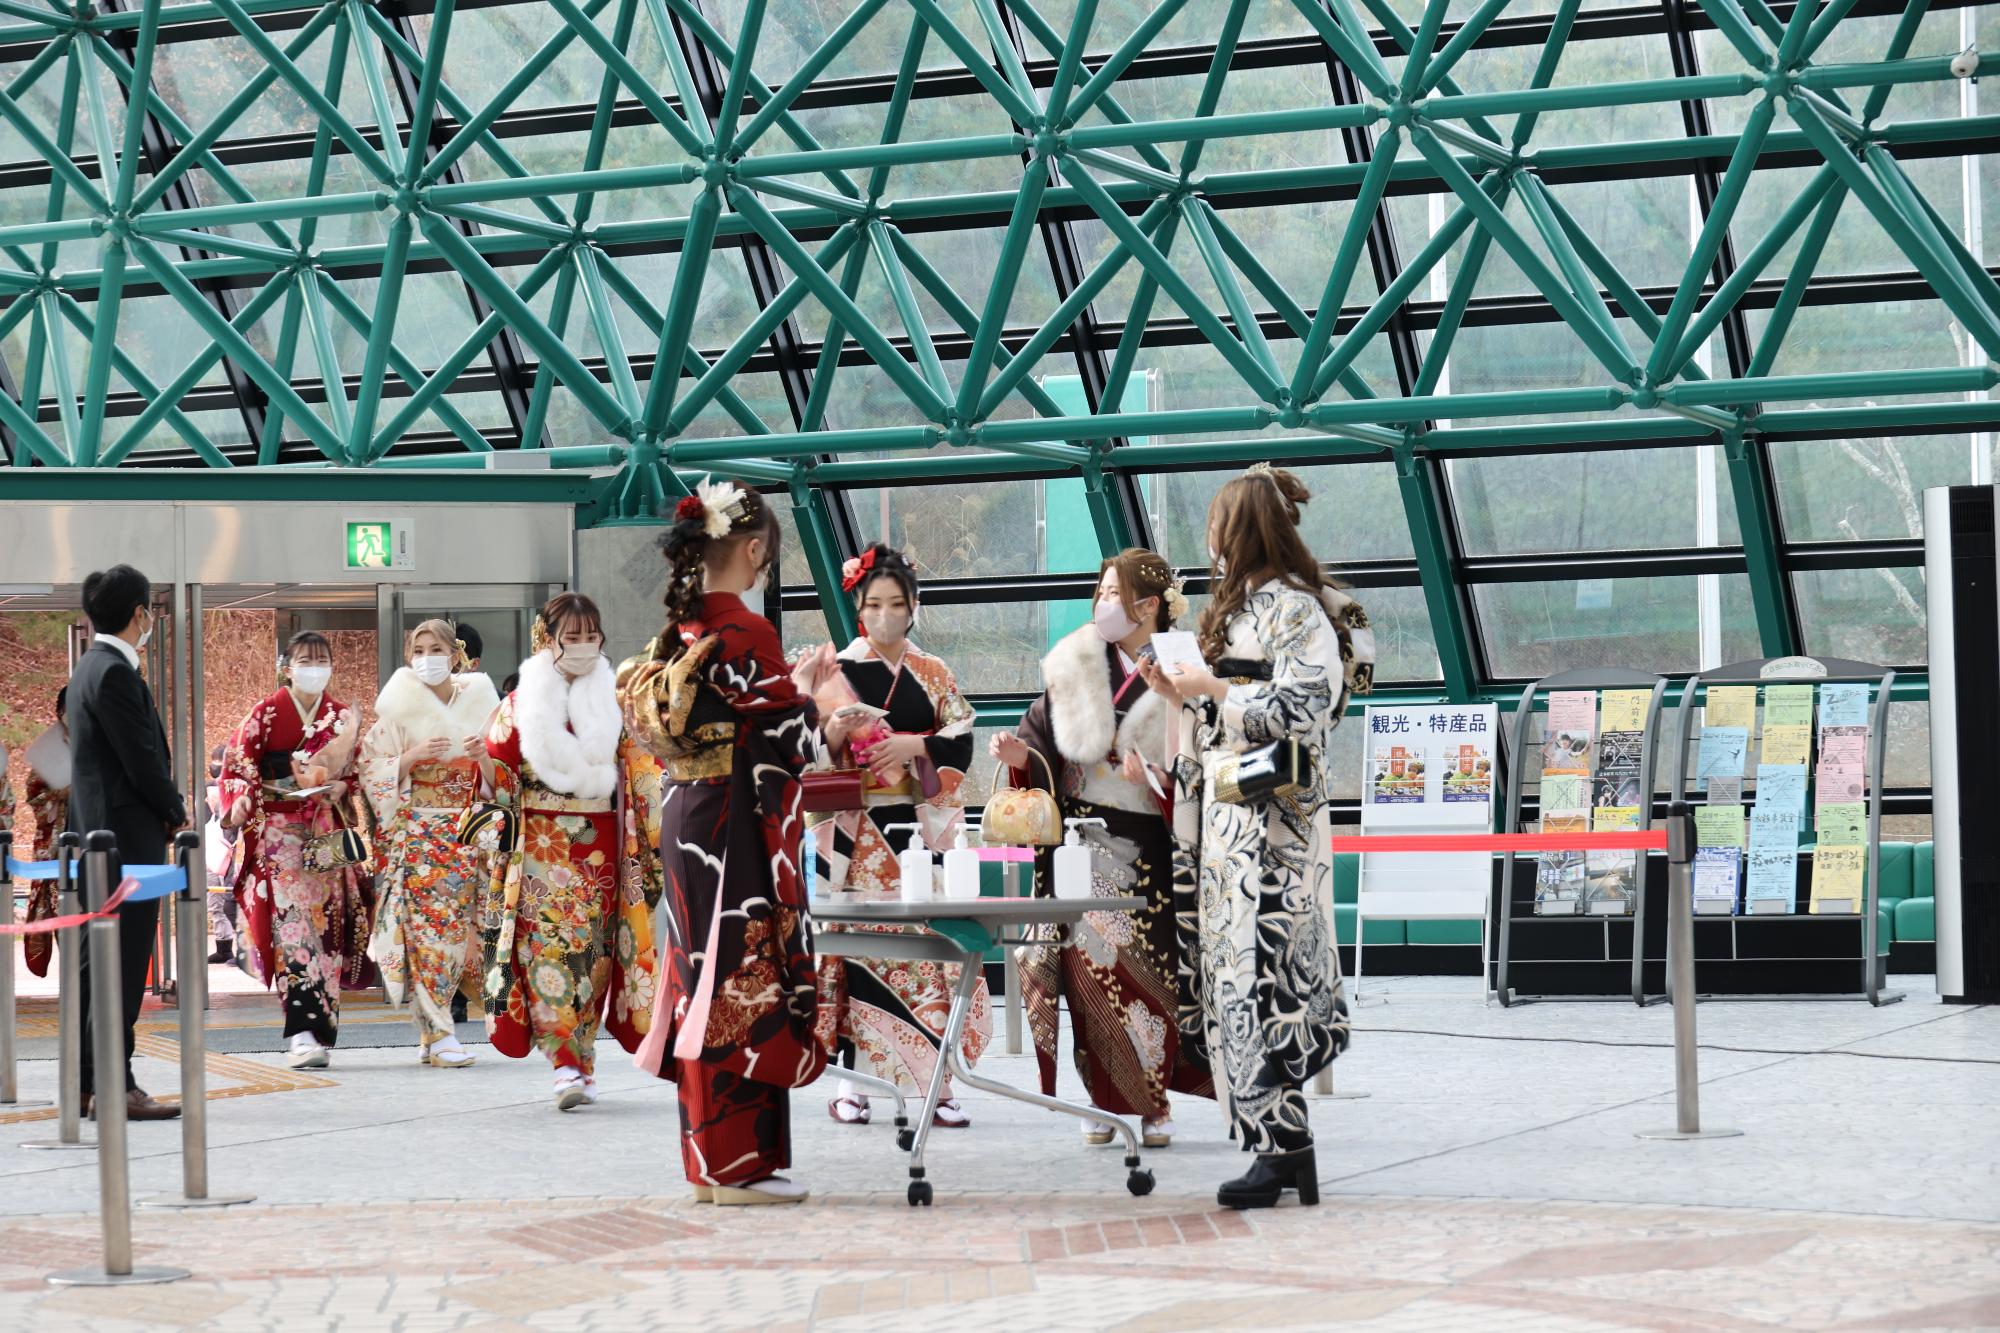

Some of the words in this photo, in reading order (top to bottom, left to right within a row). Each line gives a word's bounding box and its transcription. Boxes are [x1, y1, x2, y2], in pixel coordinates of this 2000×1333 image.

[1372, 713, 1487, 733] 観光・特産品
